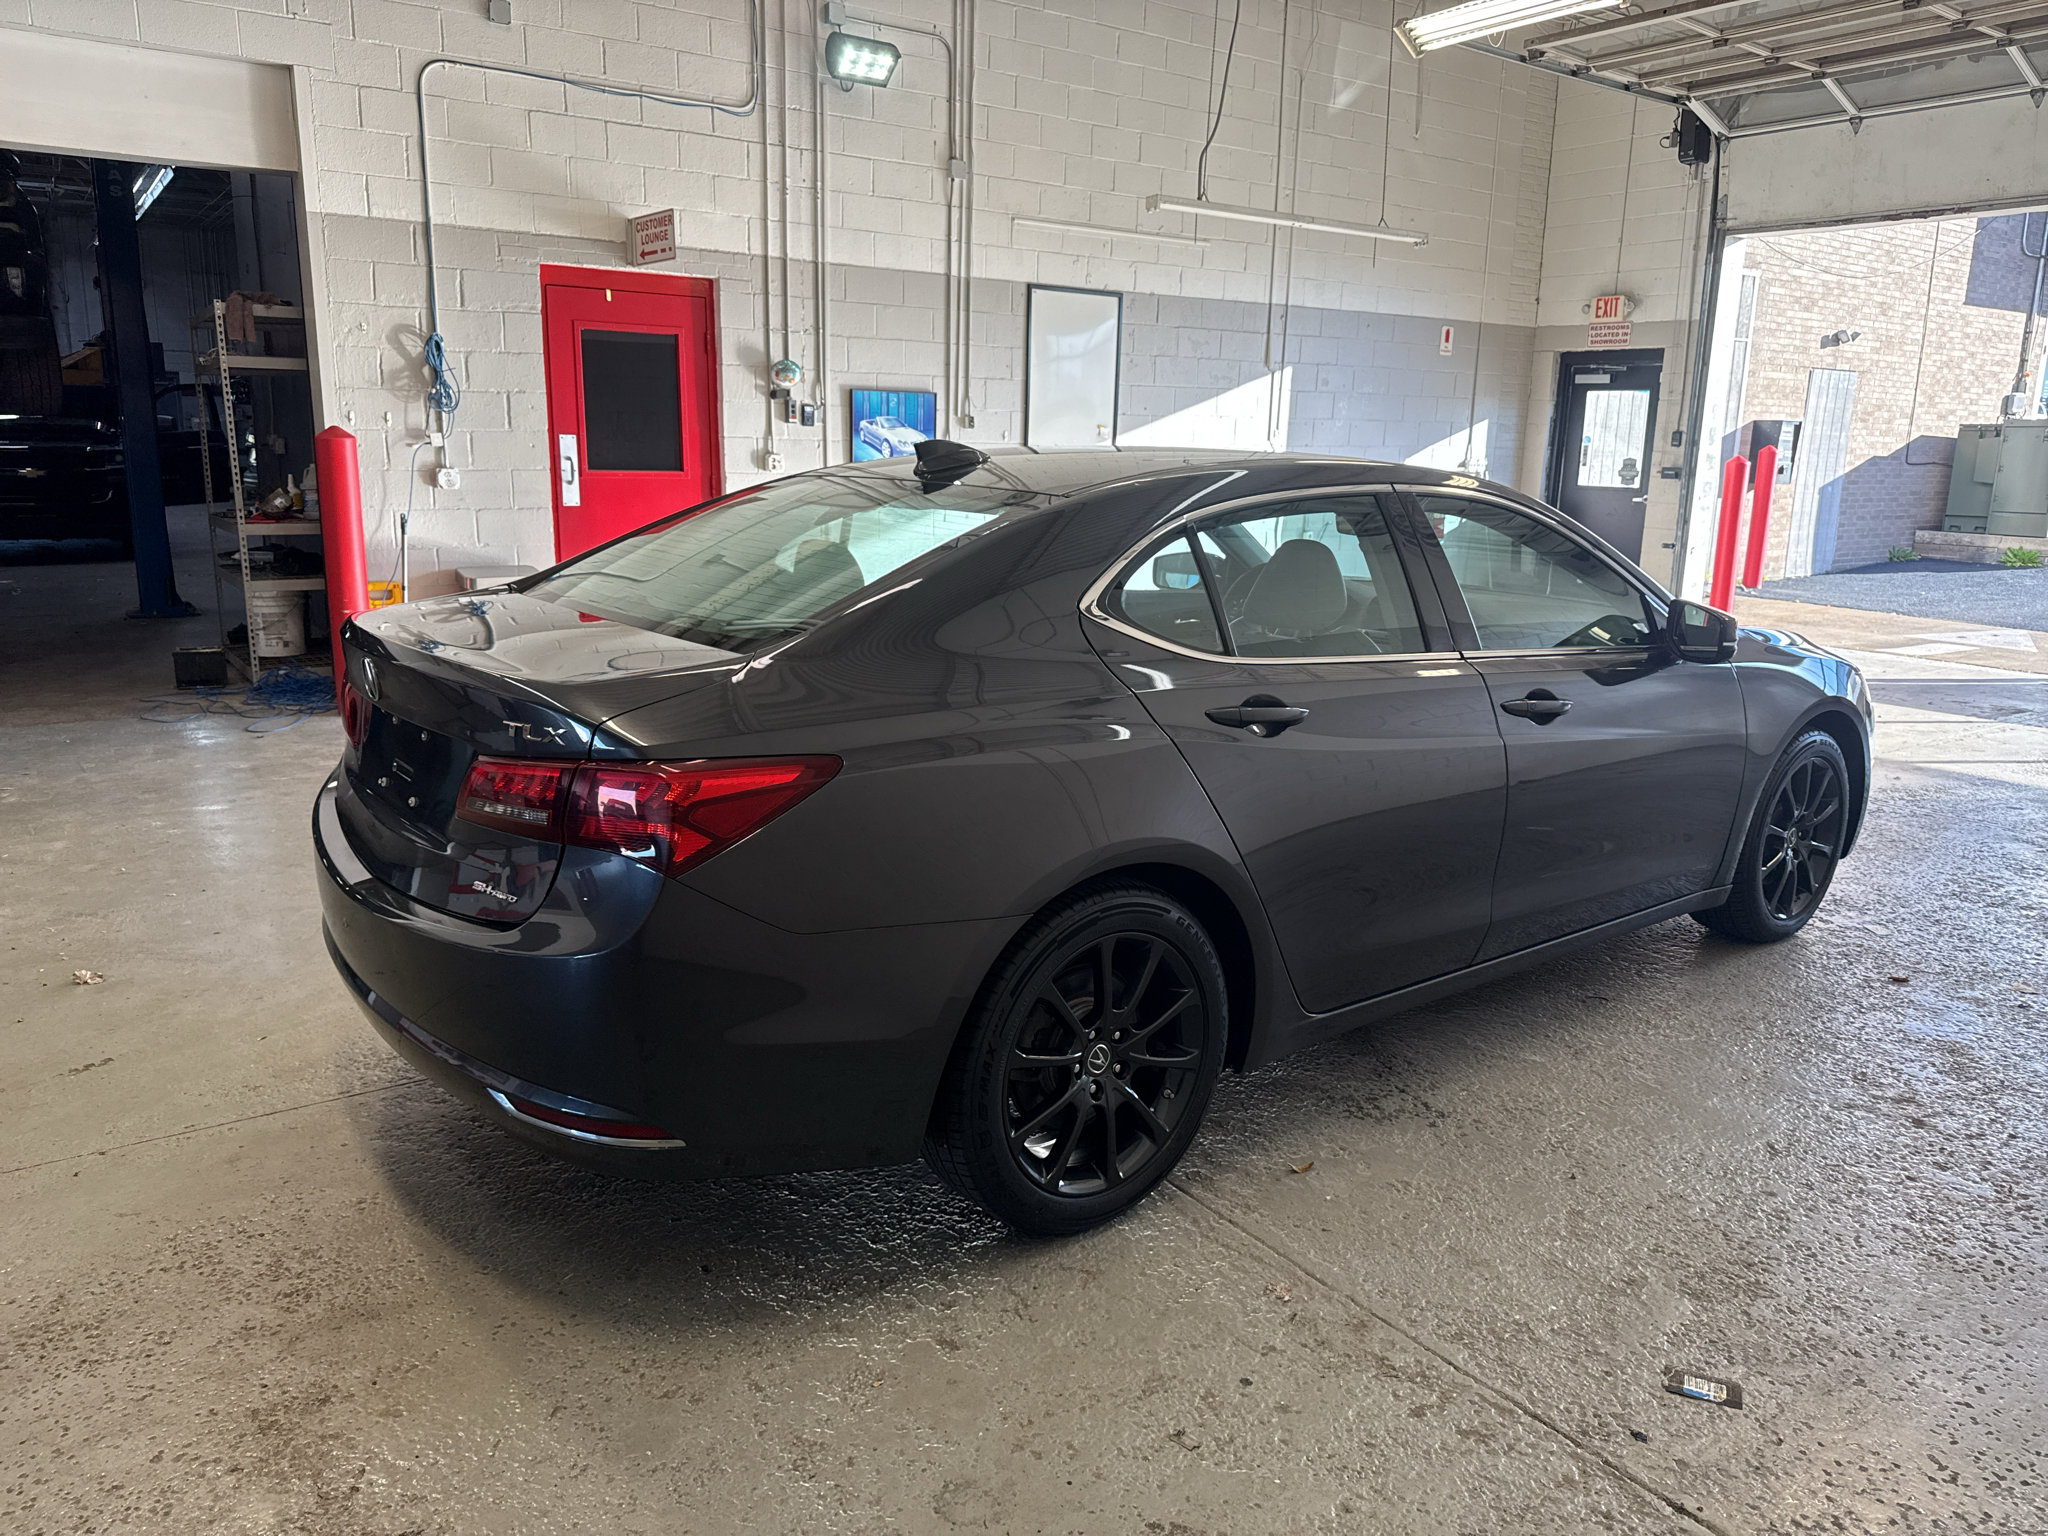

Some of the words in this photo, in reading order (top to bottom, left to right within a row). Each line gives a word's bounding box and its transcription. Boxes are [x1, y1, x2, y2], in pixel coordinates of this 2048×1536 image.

[635, 214, 673, 233] CUSTOMER
[641, 229, 669, 246] LOUNGE
[1595, 297, 1620, 318] EXIT
[503, 720, 568, 746] TLX
